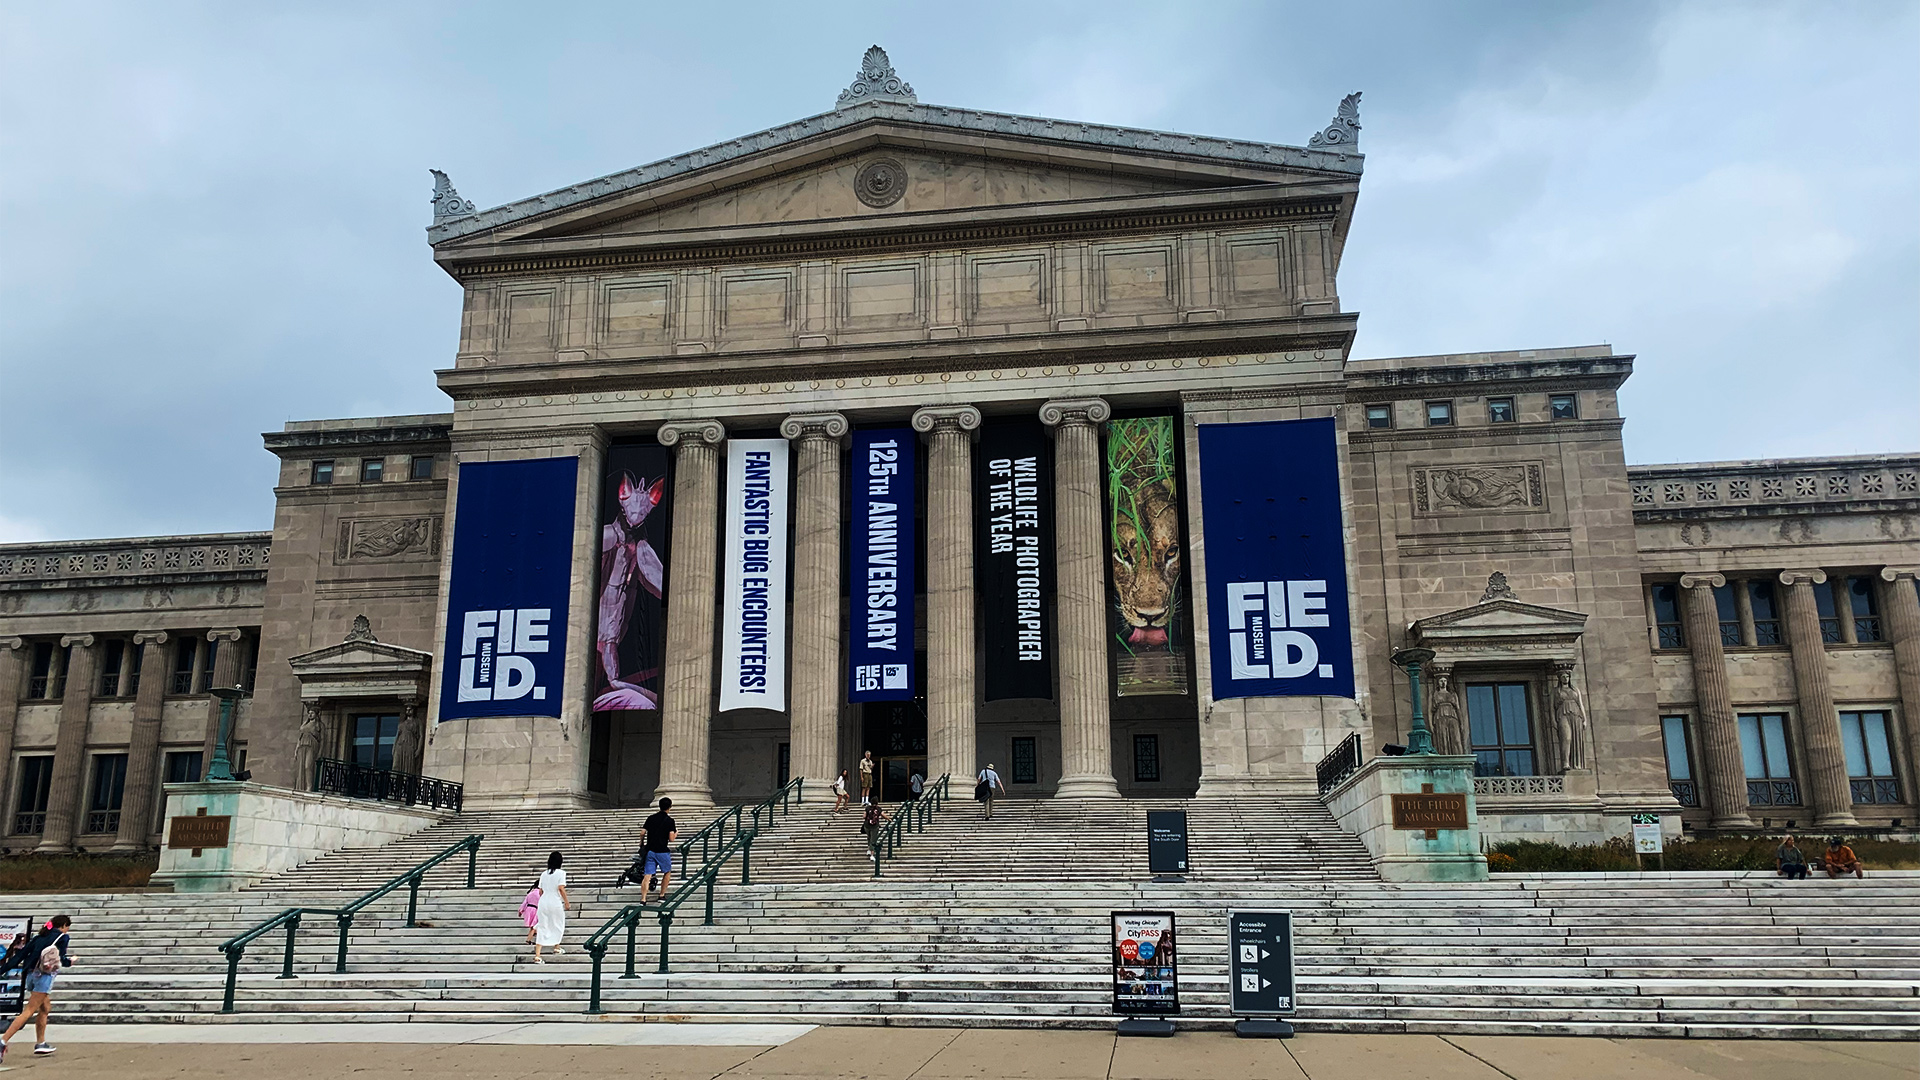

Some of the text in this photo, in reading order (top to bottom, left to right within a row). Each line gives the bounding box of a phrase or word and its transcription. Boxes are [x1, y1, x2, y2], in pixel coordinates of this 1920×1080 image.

[989, 458, 1013, 554] OF THE YEAR
[867, 439, 898, 651] 125TH ANNIVERSARY
[1014, 456, 1042, 661] WILDLIFE PHOTOGRAPHER
[739, 451, 771, 694] FANTASTIC BUG ENCOUNTERS!
[1252, 616, 1265, 660] MUSEUM
[479, 642, 492, 683] MUSEUM
[1401, 800, 1460, 810] THE FIELD
[1405, 812, 1456, 822] MUSEUM
[1127, 929, 1160, 939] CityPASS
